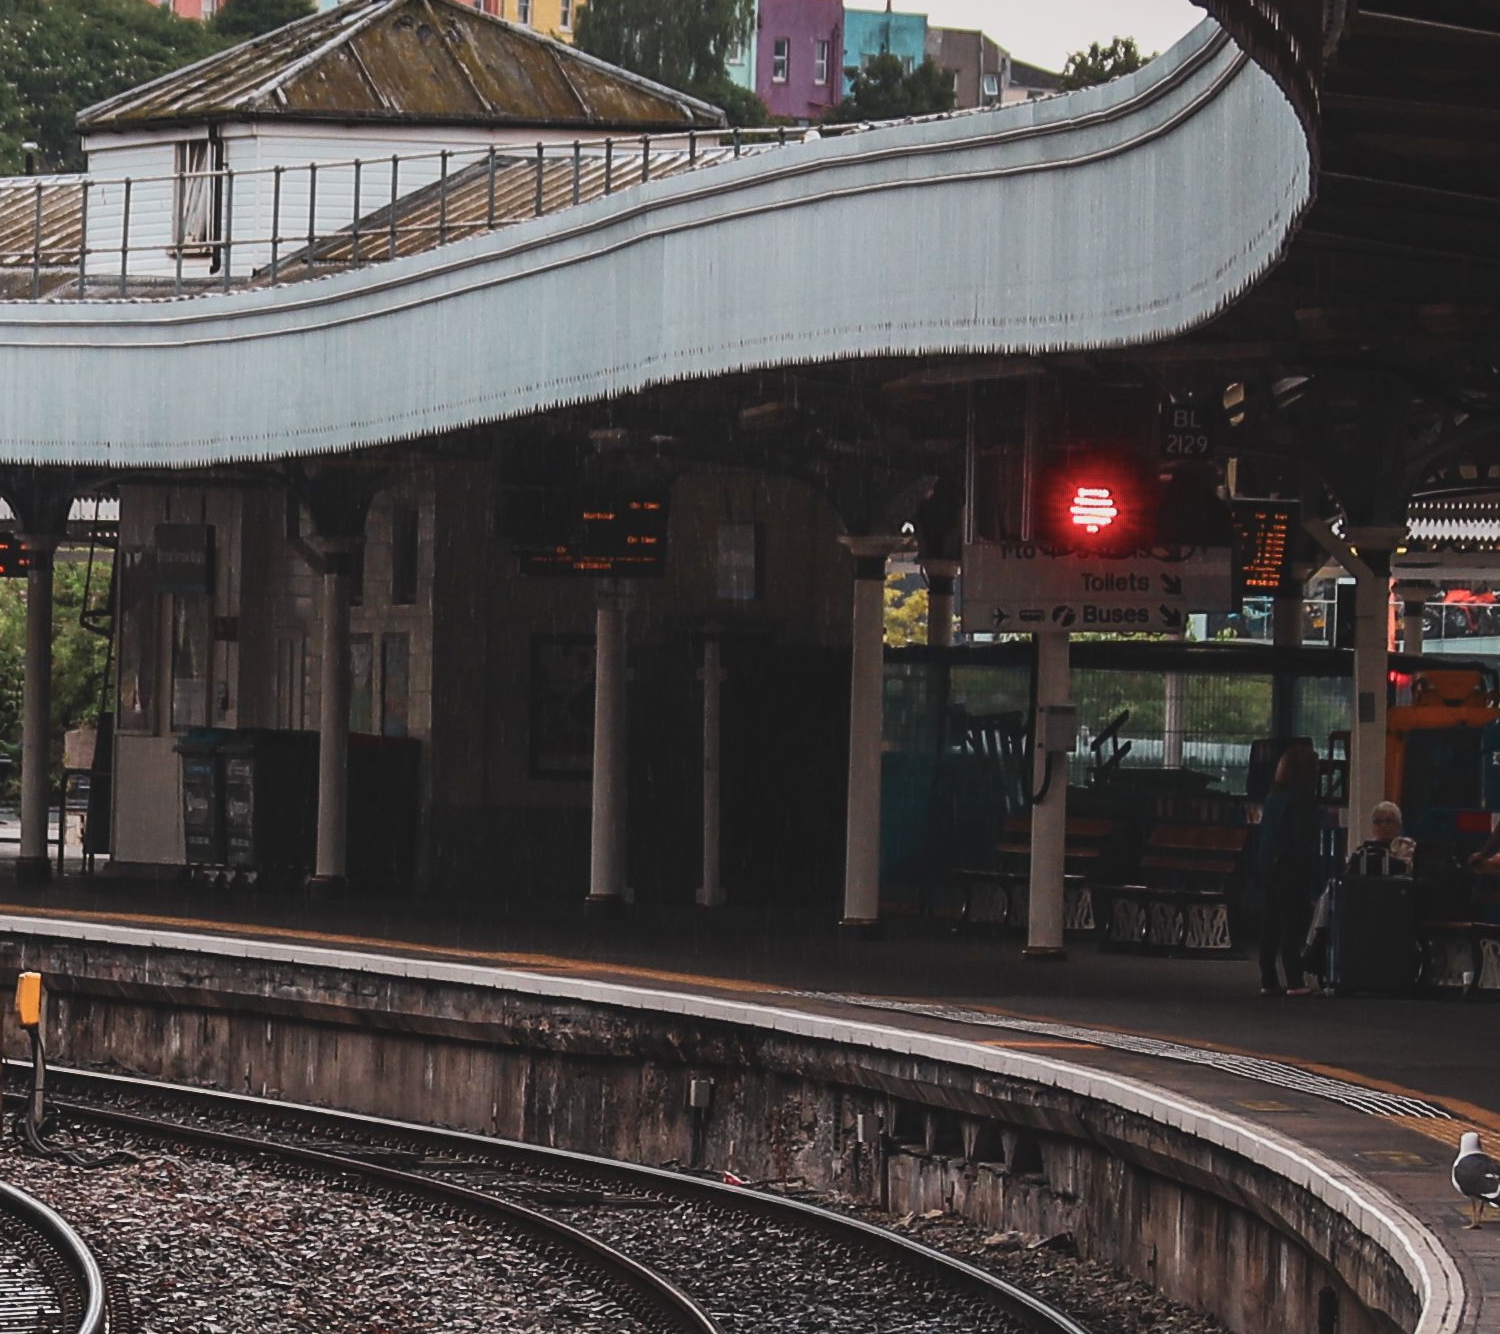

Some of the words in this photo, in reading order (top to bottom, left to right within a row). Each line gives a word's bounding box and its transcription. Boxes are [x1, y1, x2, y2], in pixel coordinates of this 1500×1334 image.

[1173, 410, 1202, 430] BL
[1165, 434, 1209, 455] 2129
[1081, 573, 1150, 592] Toilets
[1083, 605, 1149, 624] Buses
